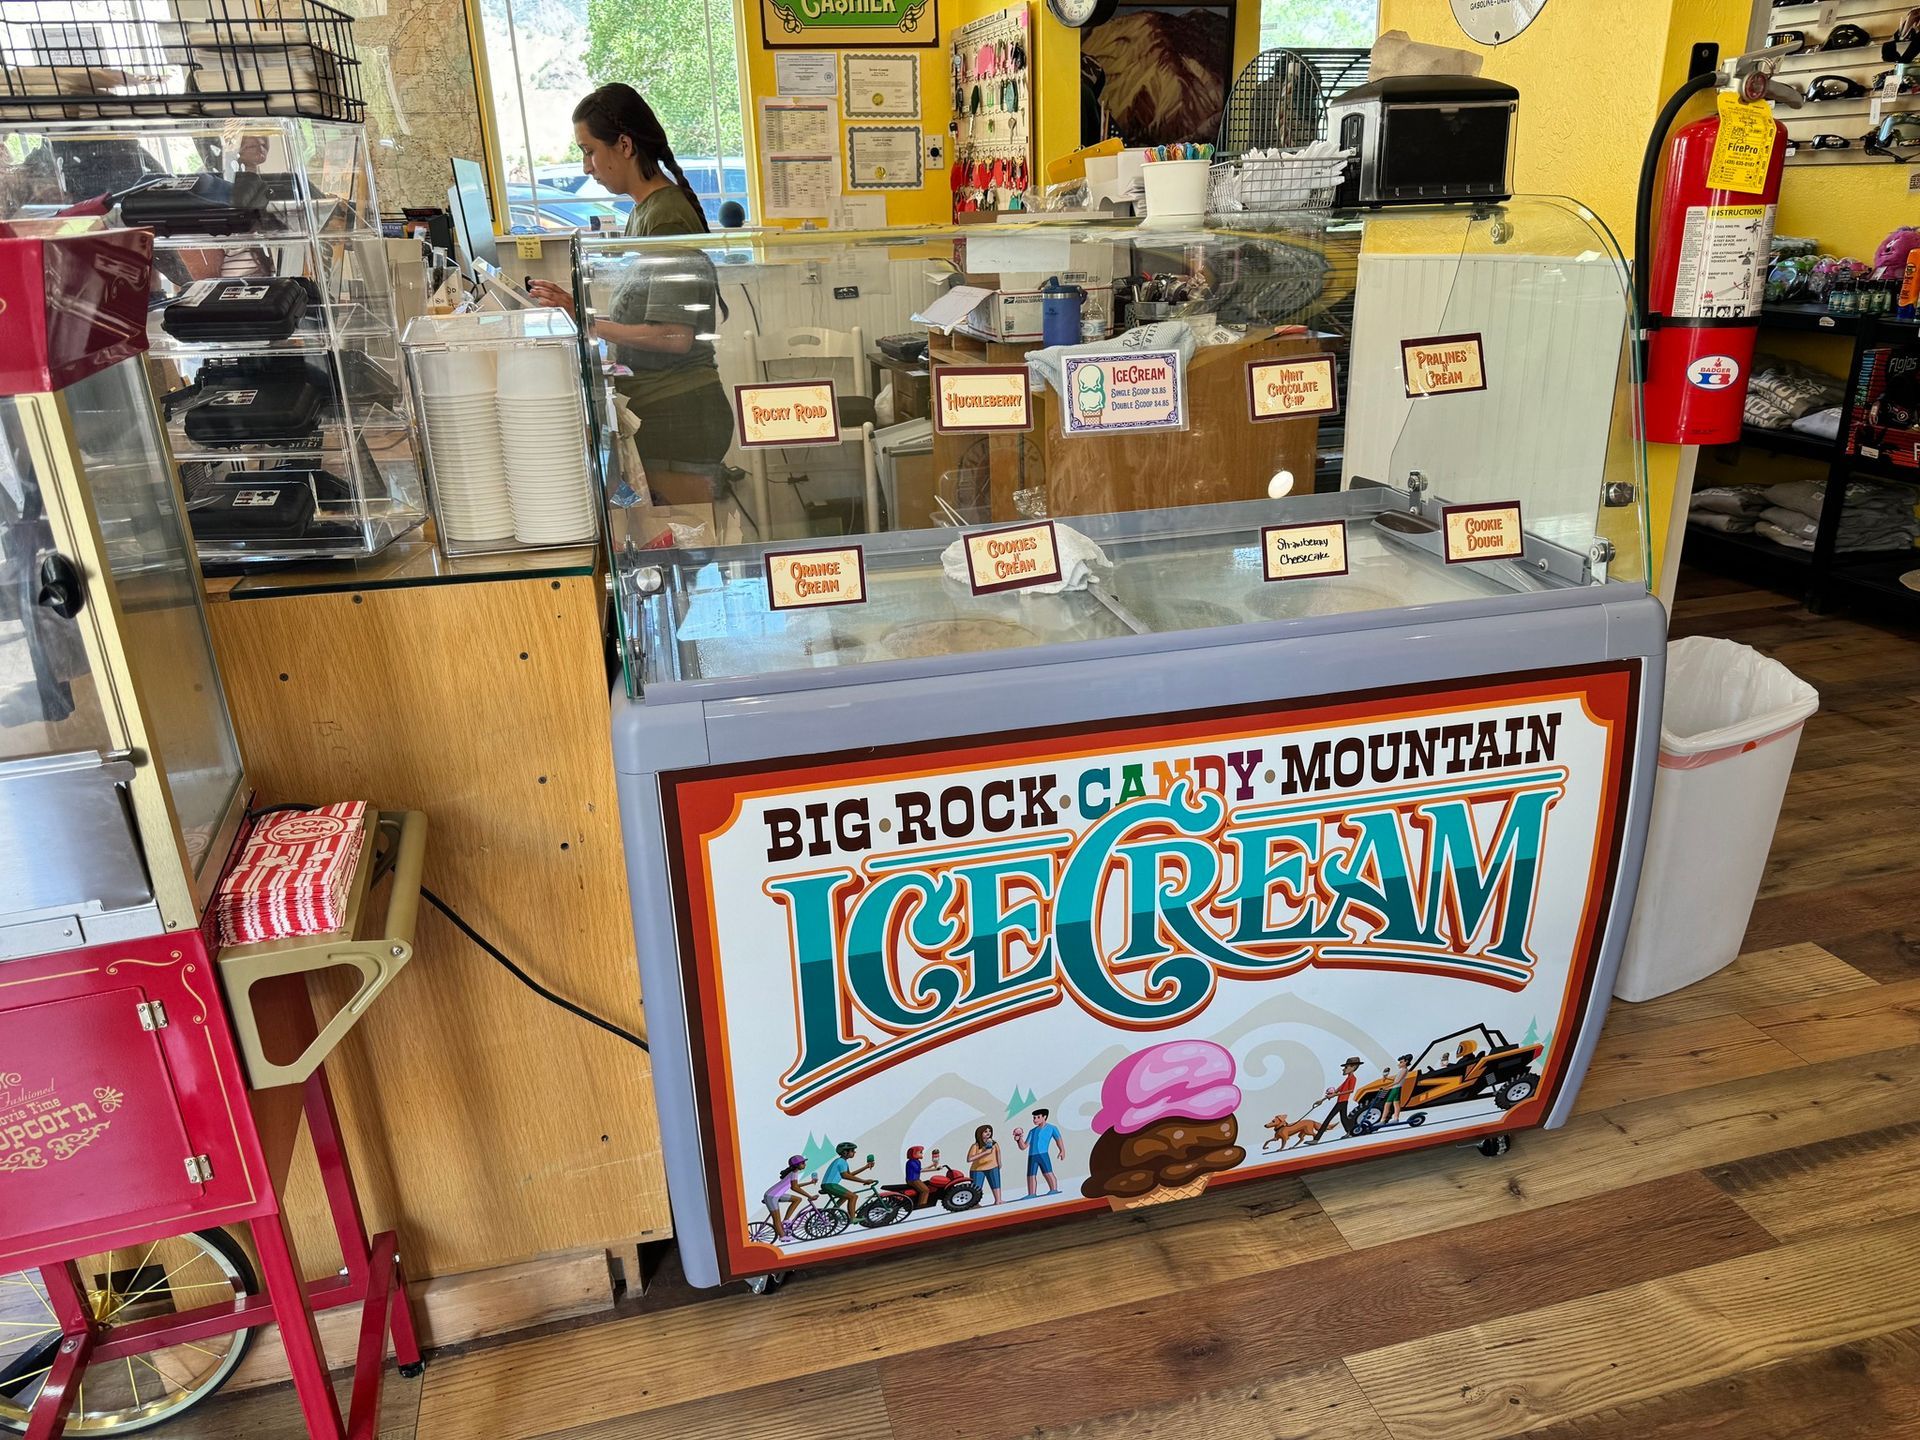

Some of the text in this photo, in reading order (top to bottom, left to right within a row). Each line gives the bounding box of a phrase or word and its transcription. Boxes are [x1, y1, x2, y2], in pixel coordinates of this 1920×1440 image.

[1728, 143, 1758, 154] FirePro
[1711, 208, 1762, 217] INSTRUCTIONS
[1416, 350, 1467, 369] PRALINES
[1280, 369, 1304, 384] MINT
[1426, 371, 1463, 388] CREAM
[1111, 388, 1130, 398] SINGLE
[1132, 387, 1150, 397] SCOOP
[1268, 382, 1319, 397] CHOCOLATE
[945, 393, 1023, 412] HUCKLEBERRY
[1111, 401, 1133, 411] DOUBLE
[1135, 400, 1153, 409] SCOOP
[752, 403, 827, 426] ROCKY ROAD
[1465, 517, 1503, 535] COOKIE
[987, 537, 1037, 558] COOKIES
[1466, 534, 1503, 551] DOUGH
[790, 562, 841, 580] ORANGE
[995, 559, 1036, 579] CREAM
[795, 579, 839, 597] CREAM
[763, 712, 1562, 863] BIG ROCK CANDY MOUNTAIN
[276, 826, 334, 836] CORN
[290, 820, 330, 828] POP
[26, 1098, 61, 1115] Time
